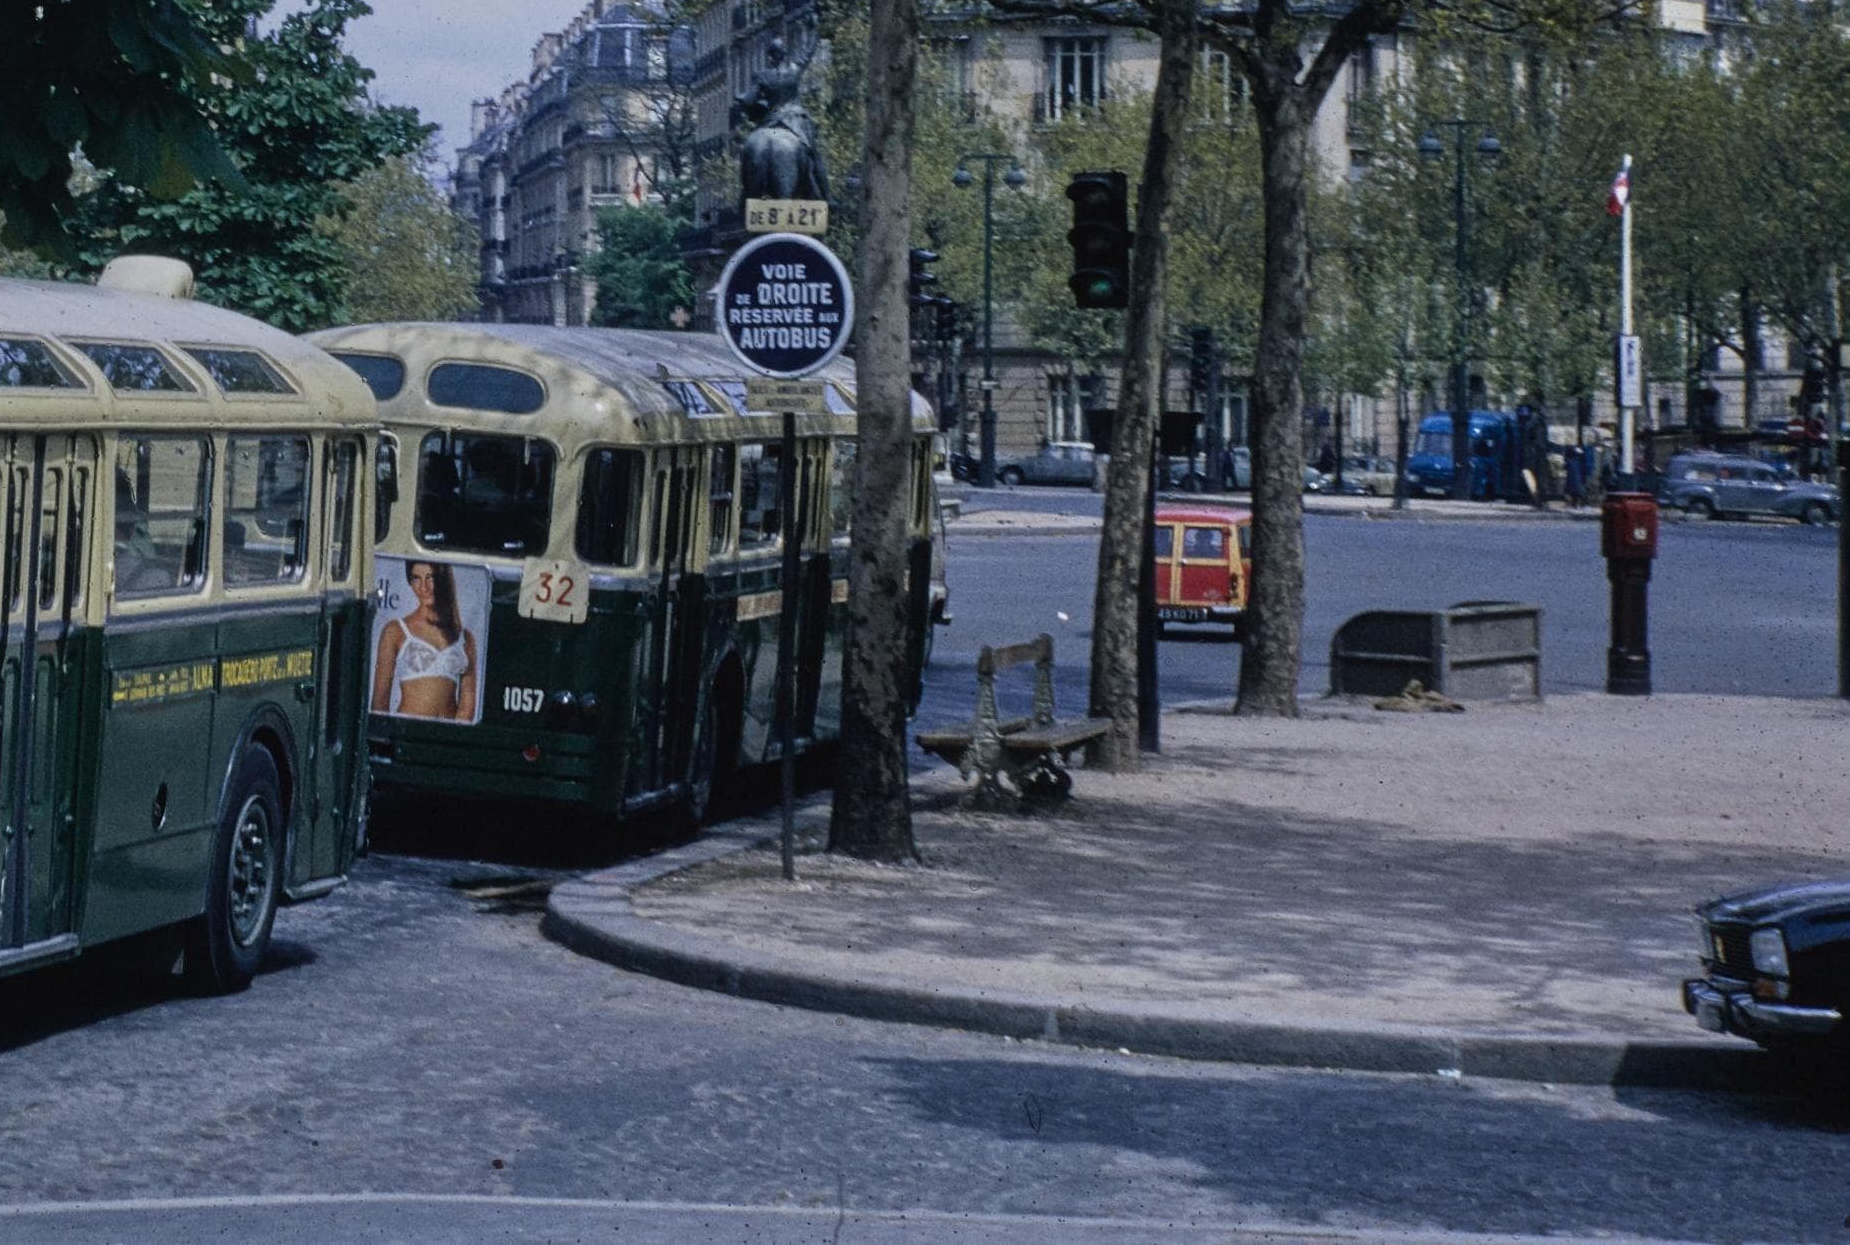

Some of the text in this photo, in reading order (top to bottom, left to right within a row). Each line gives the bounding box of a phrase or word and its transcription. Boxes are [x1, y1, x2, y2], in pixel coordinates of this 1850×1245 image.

[750, 210, 764, 226] DE
[761, 263, 807, 280] VOIE
[735, 282, 833, 305] DE DROITE
[818, 312, 840, 324] AUX
[739, 326, 832, 350] AUTOBUS
[535, 571, 575, 607] 32
[503, 686, 545, 713] 1057
